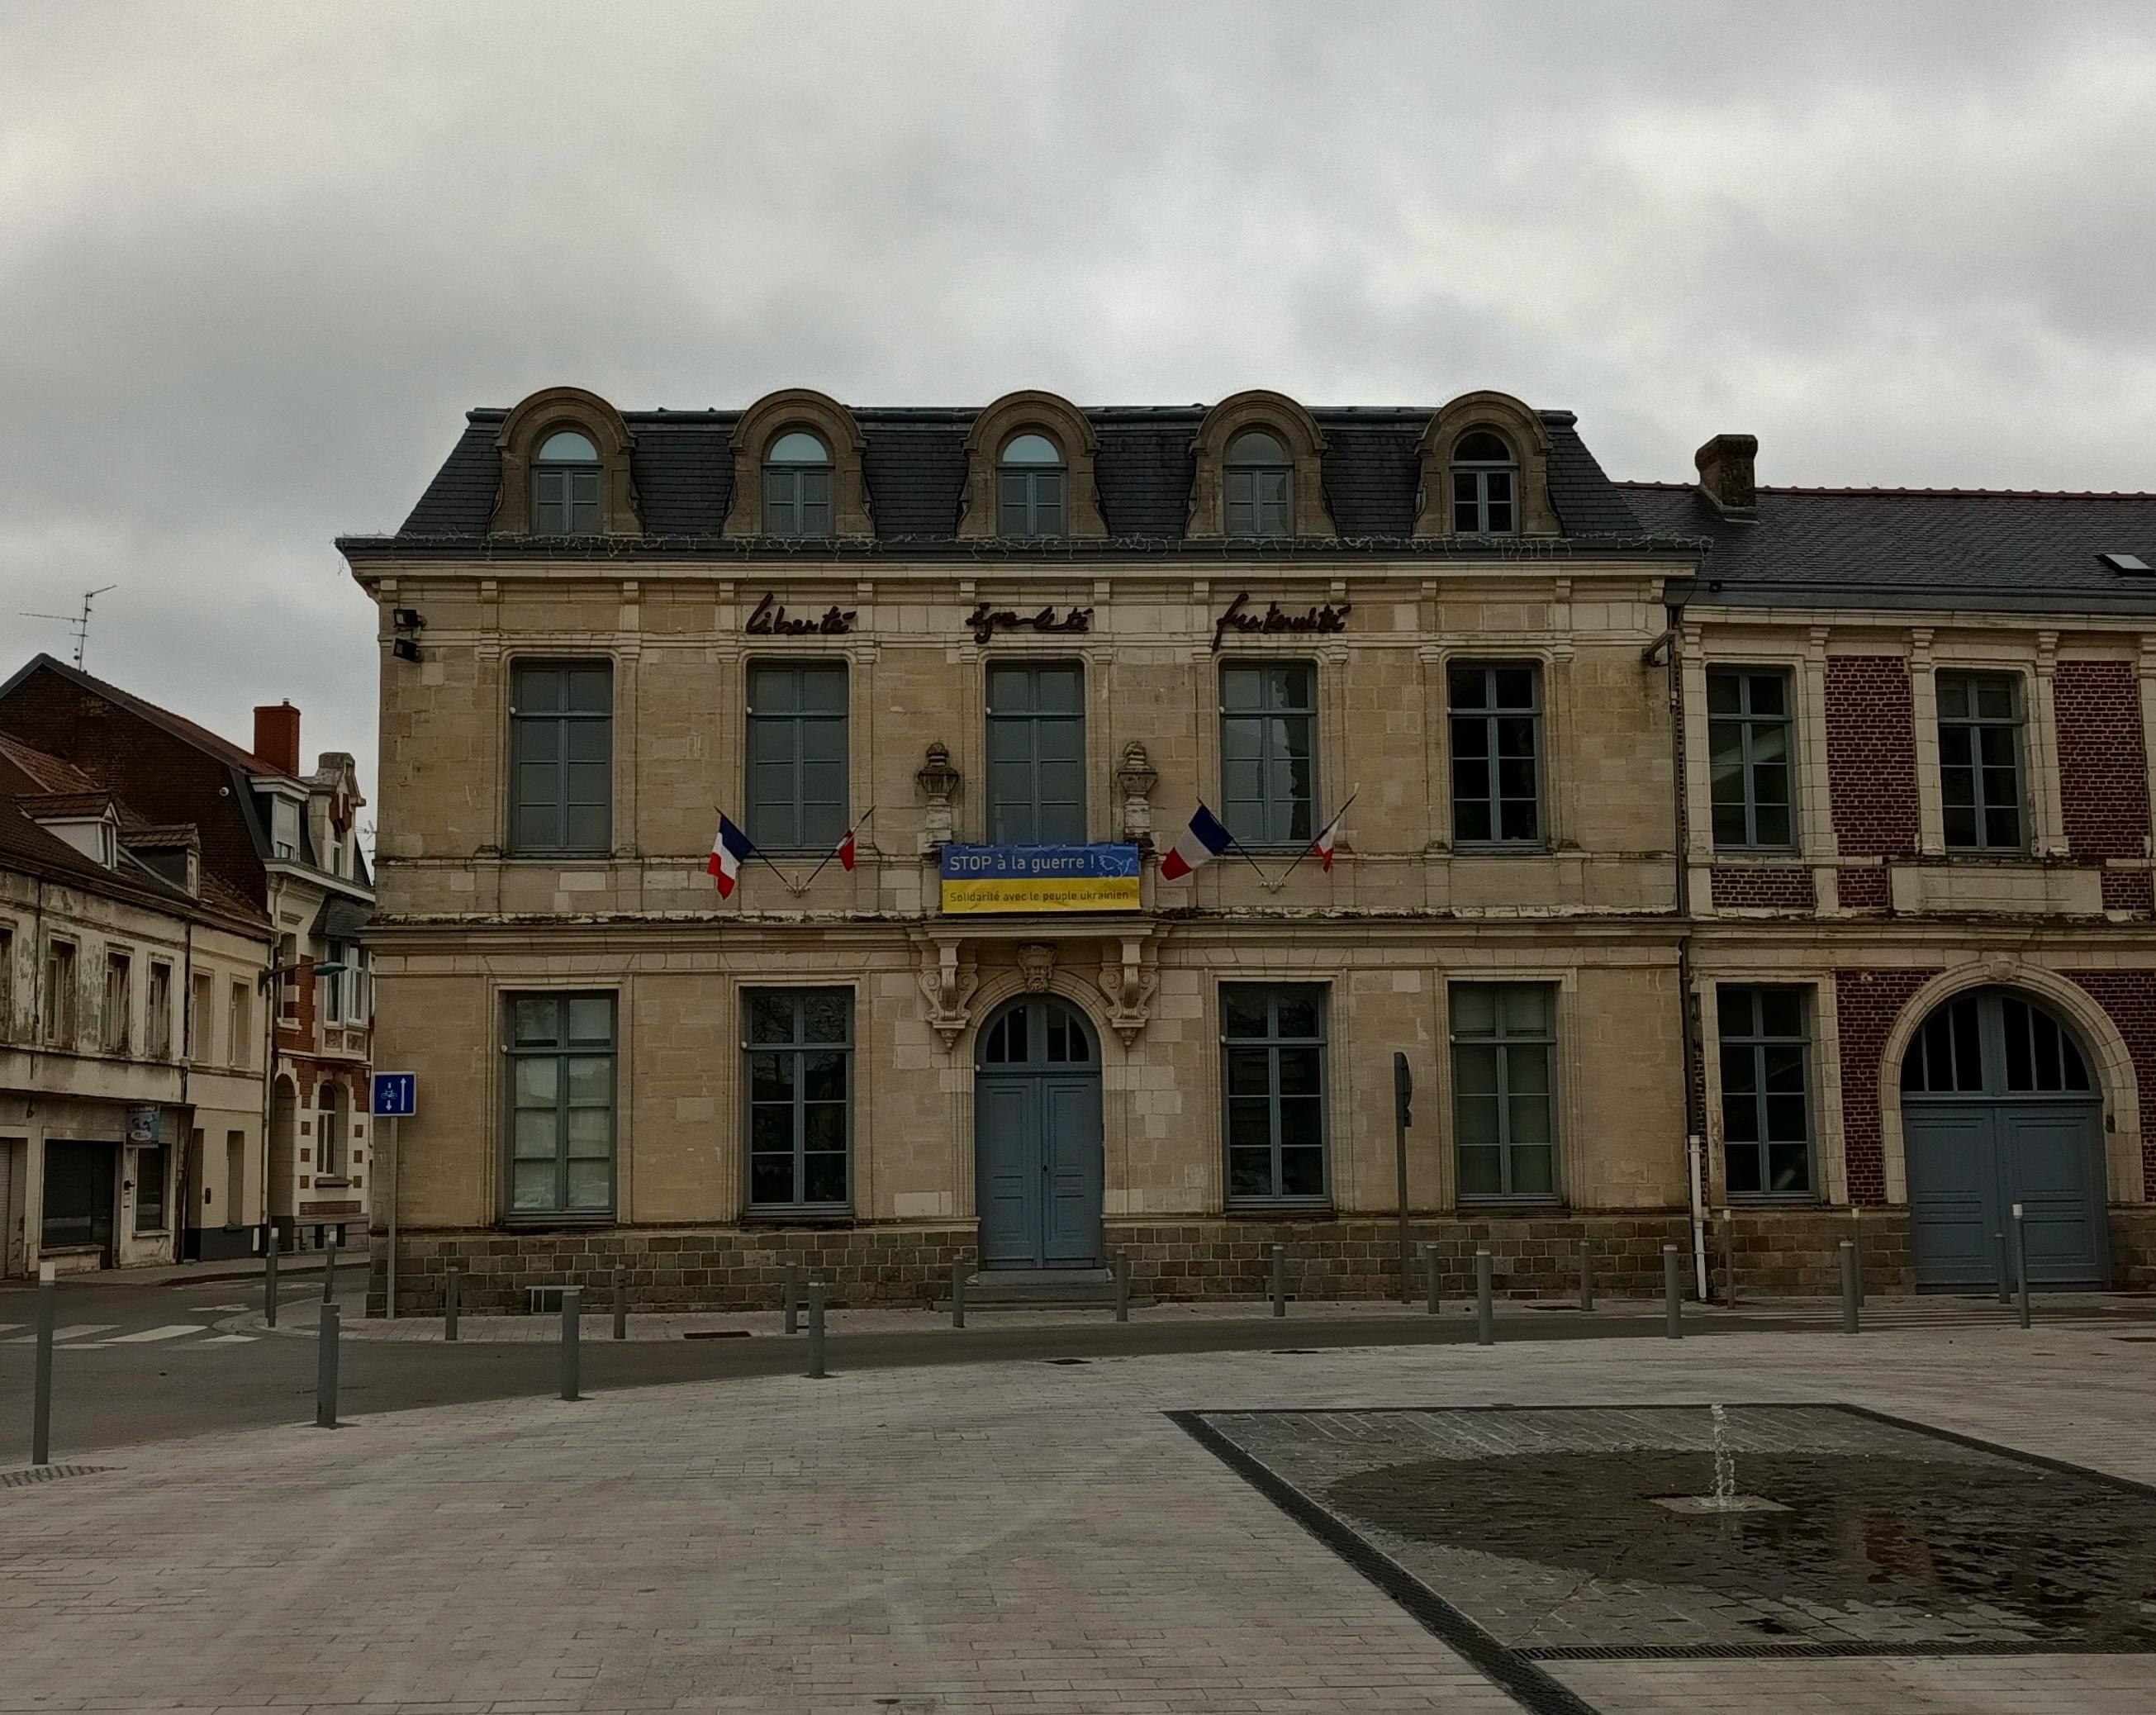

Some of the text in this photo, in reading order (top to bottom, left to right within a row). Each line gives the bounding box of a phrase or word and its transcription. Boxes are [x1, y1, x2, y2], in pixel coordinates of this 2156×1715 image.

[950, 856, 992, 871] STOP
[997, 853, 1006, 870] à
[1012, 855, 1026, 870] la
[1032, 857, 1085, 872] guerre
[950, 891, 1129, 902] Solidarité avec le peuple ukrainien
